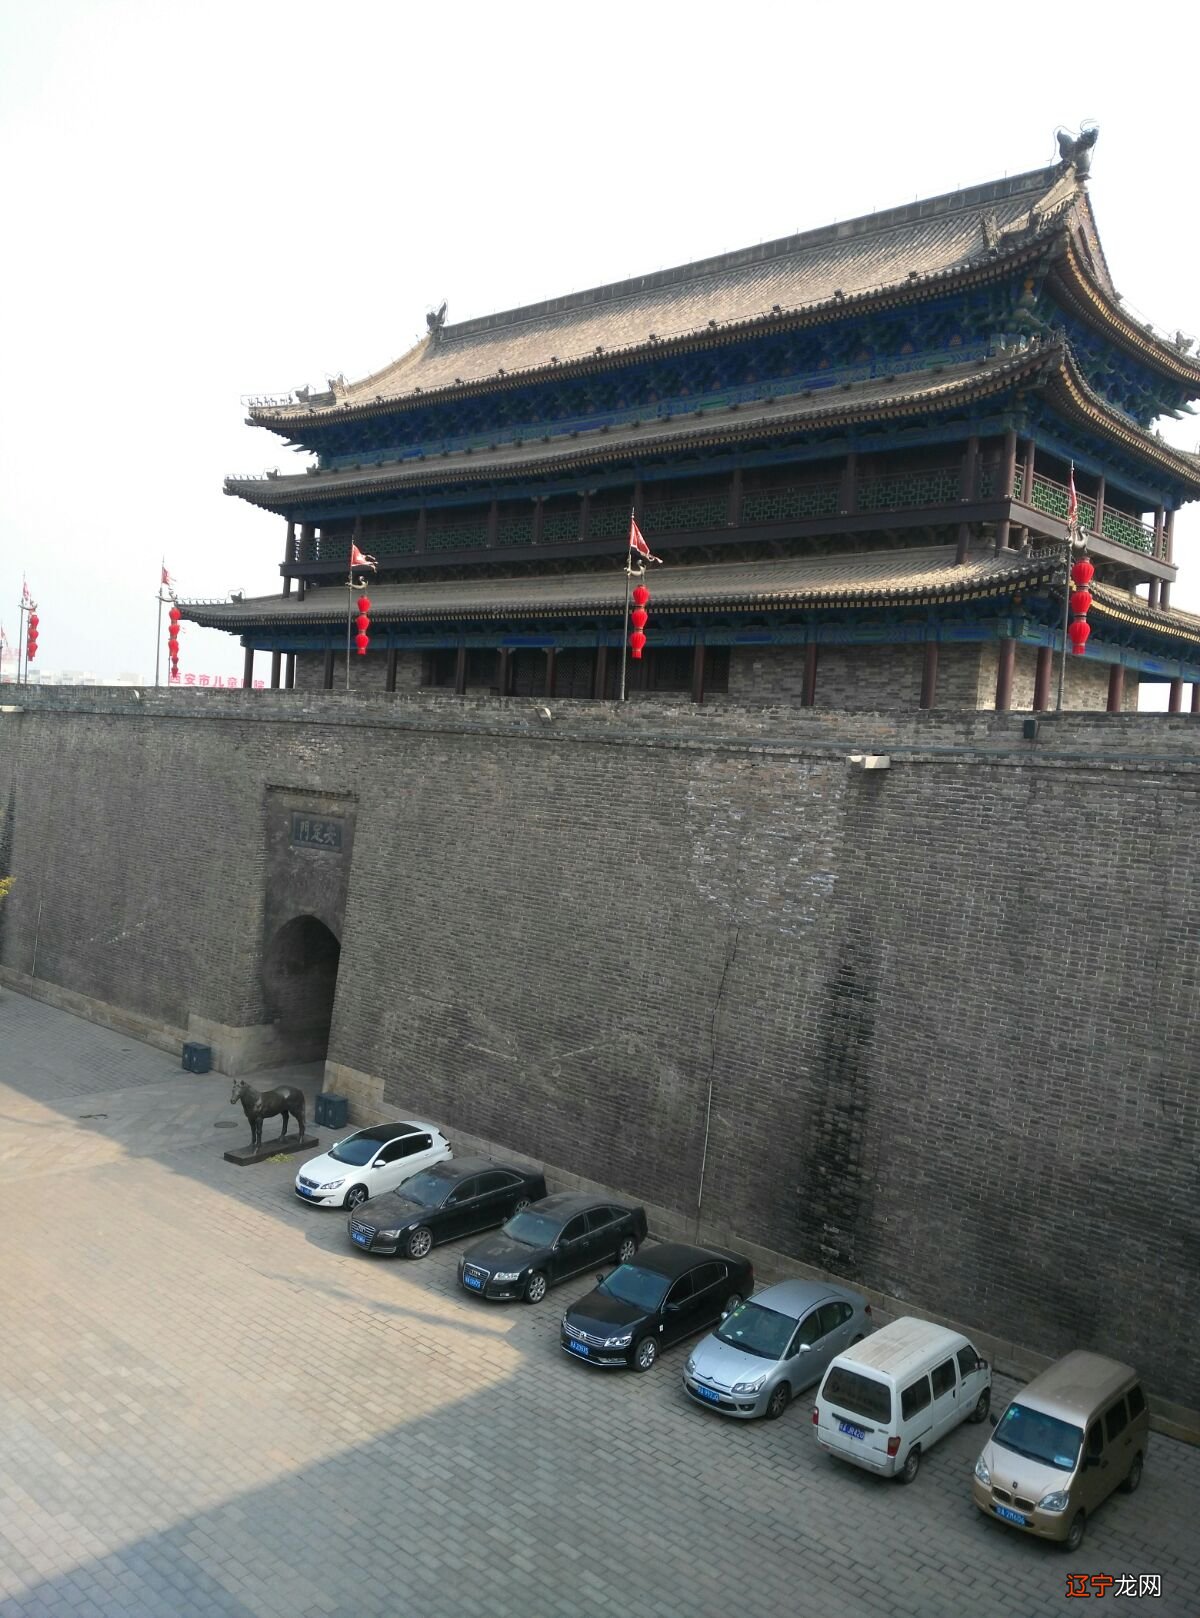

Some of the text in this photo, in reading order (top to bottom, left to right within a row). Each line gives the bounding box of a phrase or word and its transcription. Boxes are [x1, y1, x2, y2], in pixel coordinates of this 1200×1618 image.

[169, 672, 265, 690] 西安市儿童院
